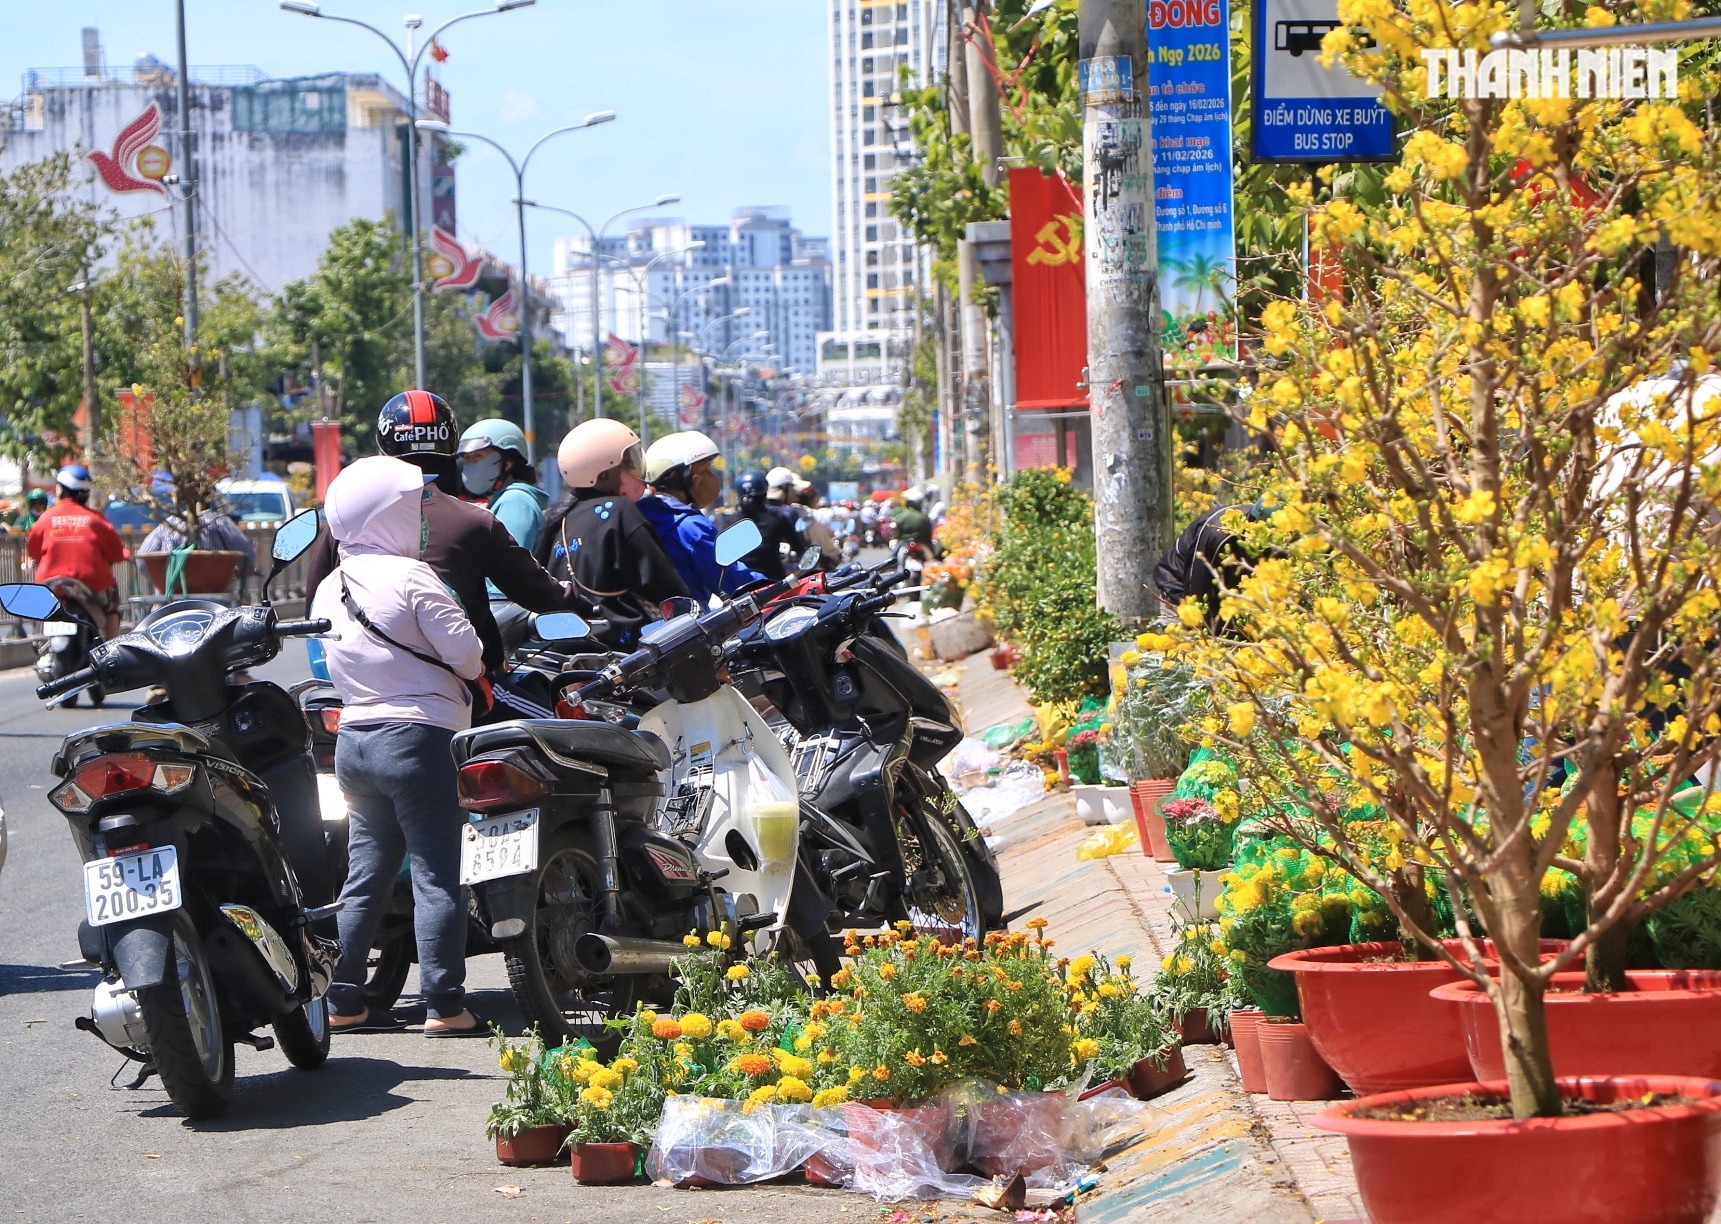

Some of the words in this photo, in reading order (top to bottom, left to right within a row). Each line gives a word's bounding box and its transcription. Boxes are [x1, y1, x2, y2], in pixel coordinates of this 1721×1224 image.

[1158, 45, 1184, 67] Ngọ
[1187, 43, 1221, 62] 2026
[1161, 80, 1174, 95] tổ
[1176, 80, 1206, 95] chức
[1170, 100, 1187, 113] ngày
[1188, 98, 1225, 110] 16/02/2026
[1159, 115, 1167, 124] 29
[1263, 102, 1295, 127] ĐIỂM
[1297, 104, 1334, 126] DỪNG
[1334, 107, 1352, 125] XE
[1353, 103, 1386, 125] BUÝT
[1159, 135, 1184, 148] khai
[1186, 136, 1210, 149] mạc
[1294, 133, 1320, 150] BUS
[1321, 132, 1354, 150] STOP
[1161, 149, 1214, 161] 11/02/2026
[1172, 164, 1191, 174] chạp
[1205, 162, 1222, 173] lịch)
[1156, 184, 1184, 200] điểm
[393, 430, 414, 442] Café
[414, 421, 449, 441] PHỐ
[206, 759, 246, 777] VISION
[98, 853, 163, 891] 59-LA
[95, 880, 173, 921] 200.35
